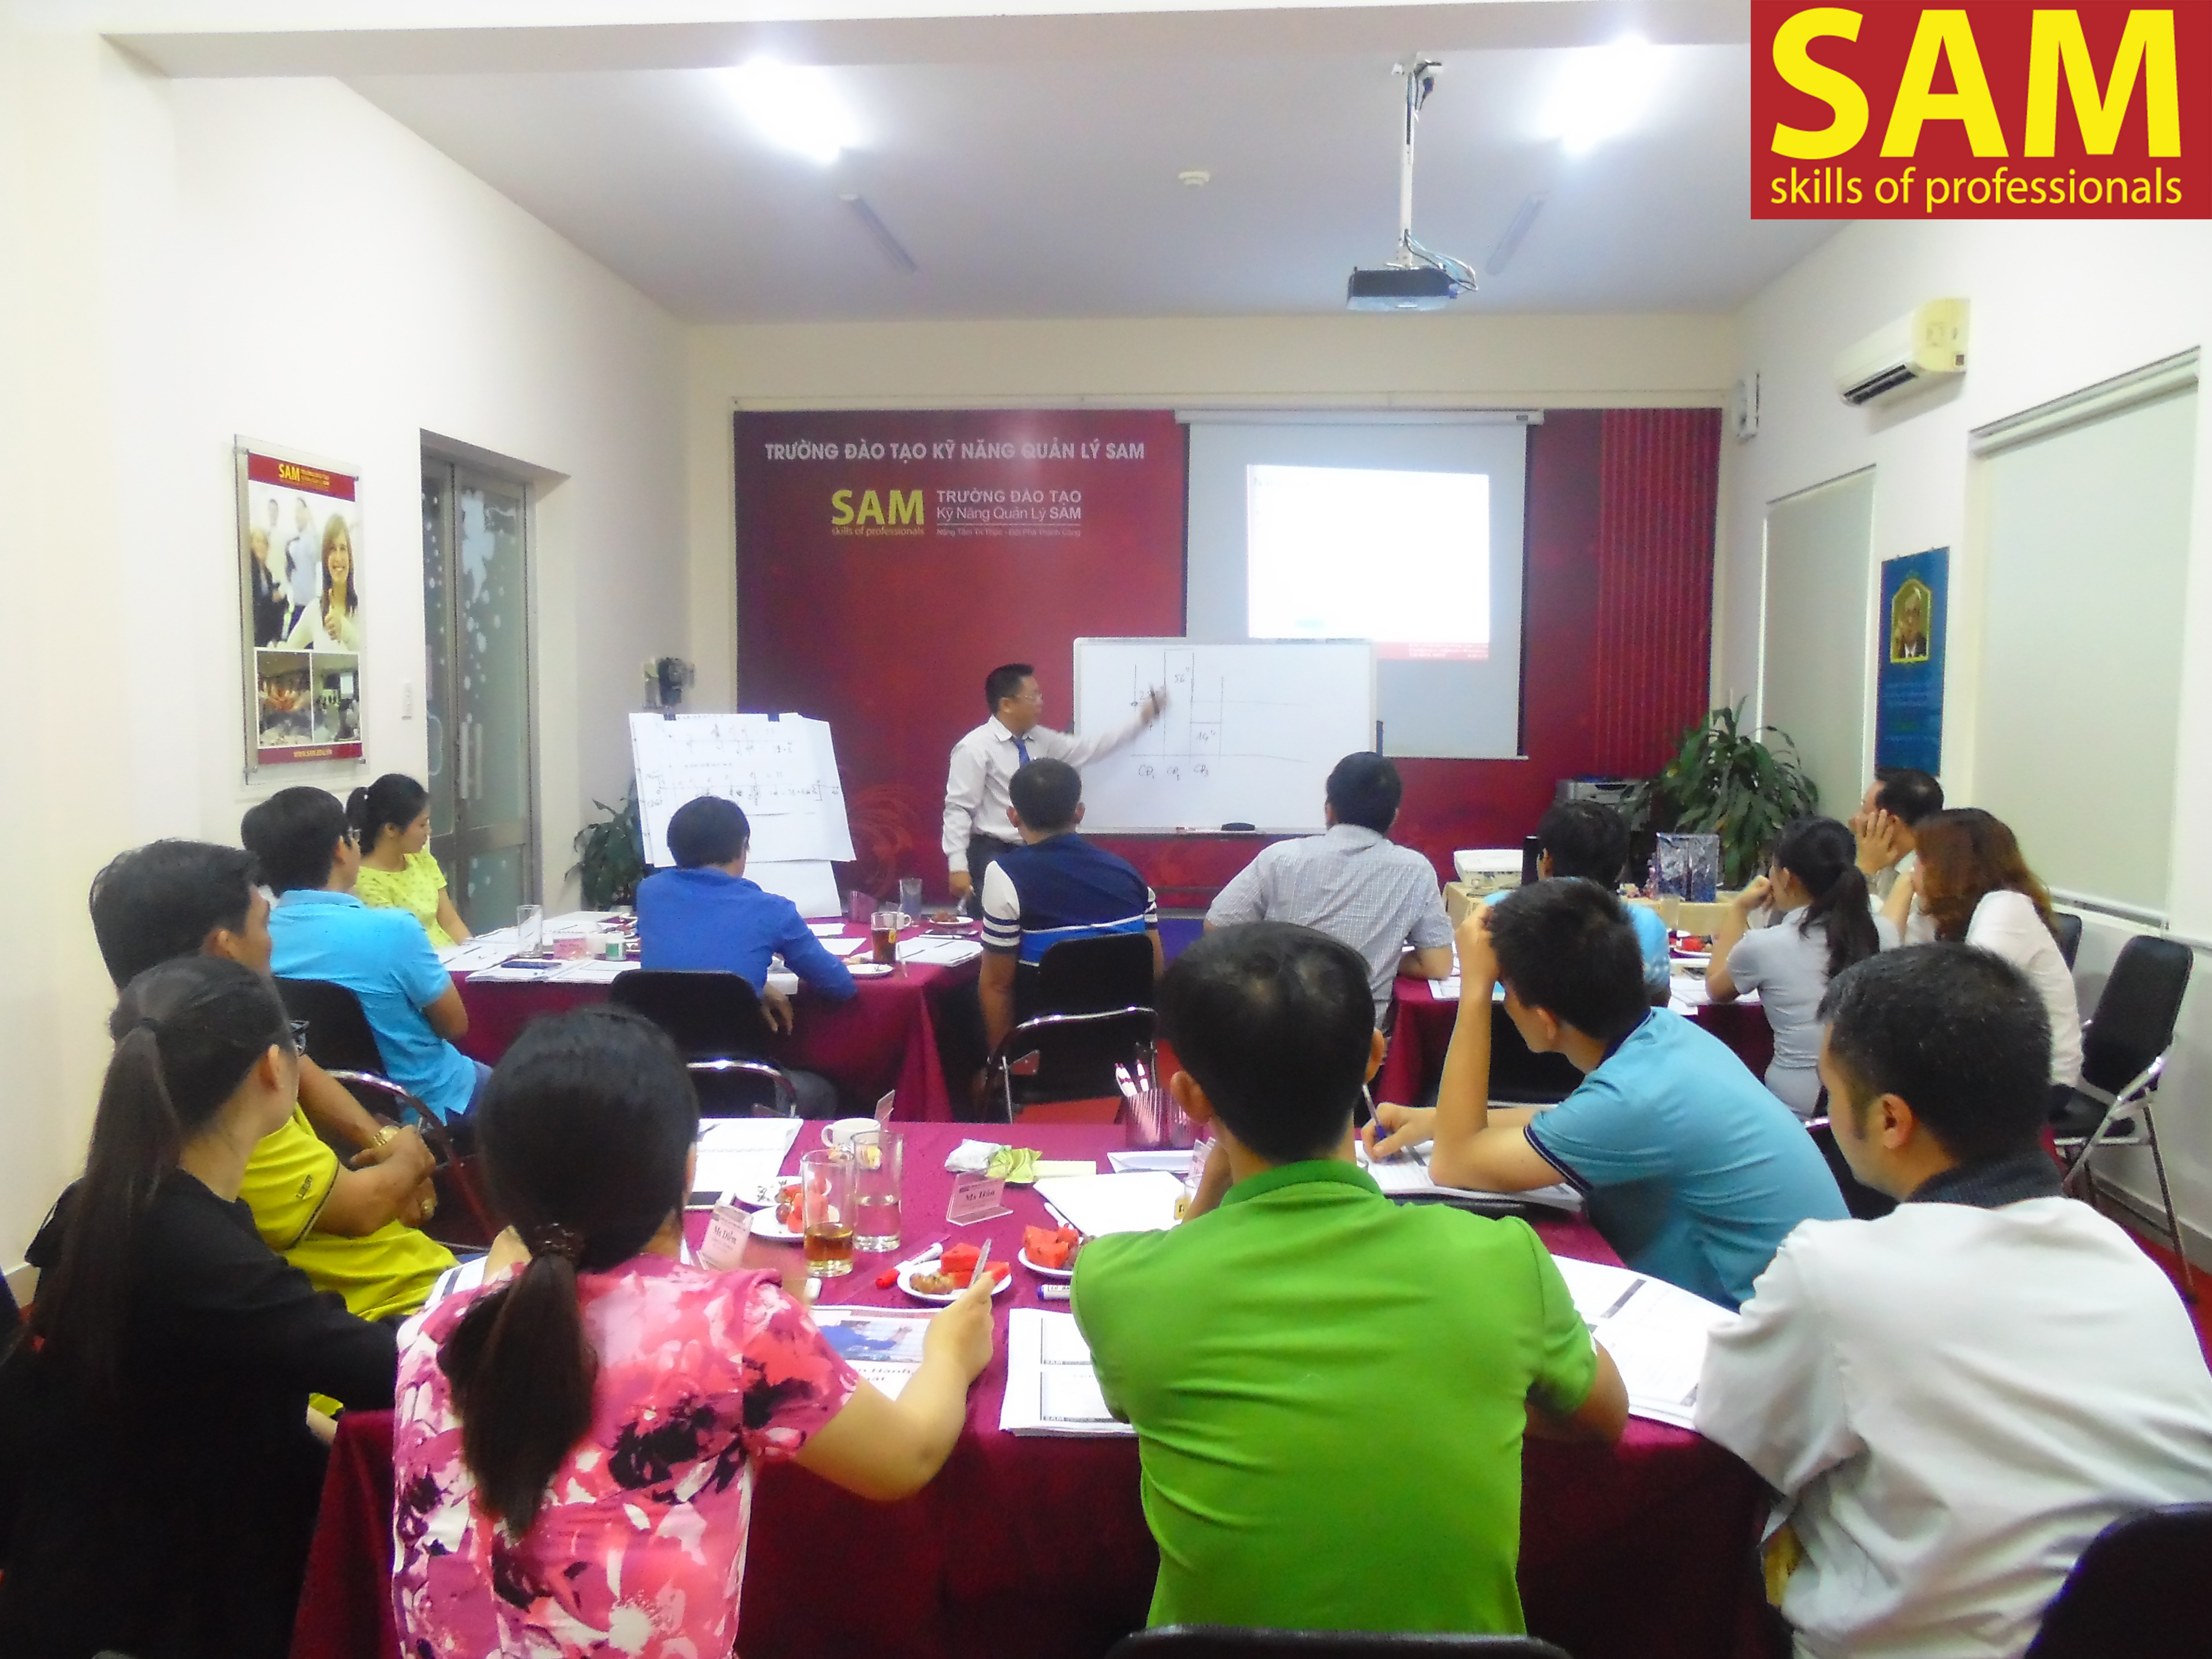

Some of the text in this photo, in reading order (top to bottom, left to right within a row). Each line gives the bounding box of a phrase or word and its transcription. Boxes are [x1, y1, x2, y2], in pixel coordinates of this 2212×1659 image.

[765, 437, 1144, 464] TRƯỜNG ĐÀO TẠO KỸ NĂNG QUẢN LÝ SAM
[279, 463, 300, 482] SAM
[937, 488, 1081, 505] TRƯỜNG ĐÀO TẠO
[832, 490, 924, 525] SAM
[957, 507, 990, 522] Năng
[993, 506, 1028, 519] Quản
[1032, 507, 1046, 522] Lý
[1049, 507, 1081, 519] SAM
[855, 527, 865, 535] of
[866, 527, 924, 536] professionals
